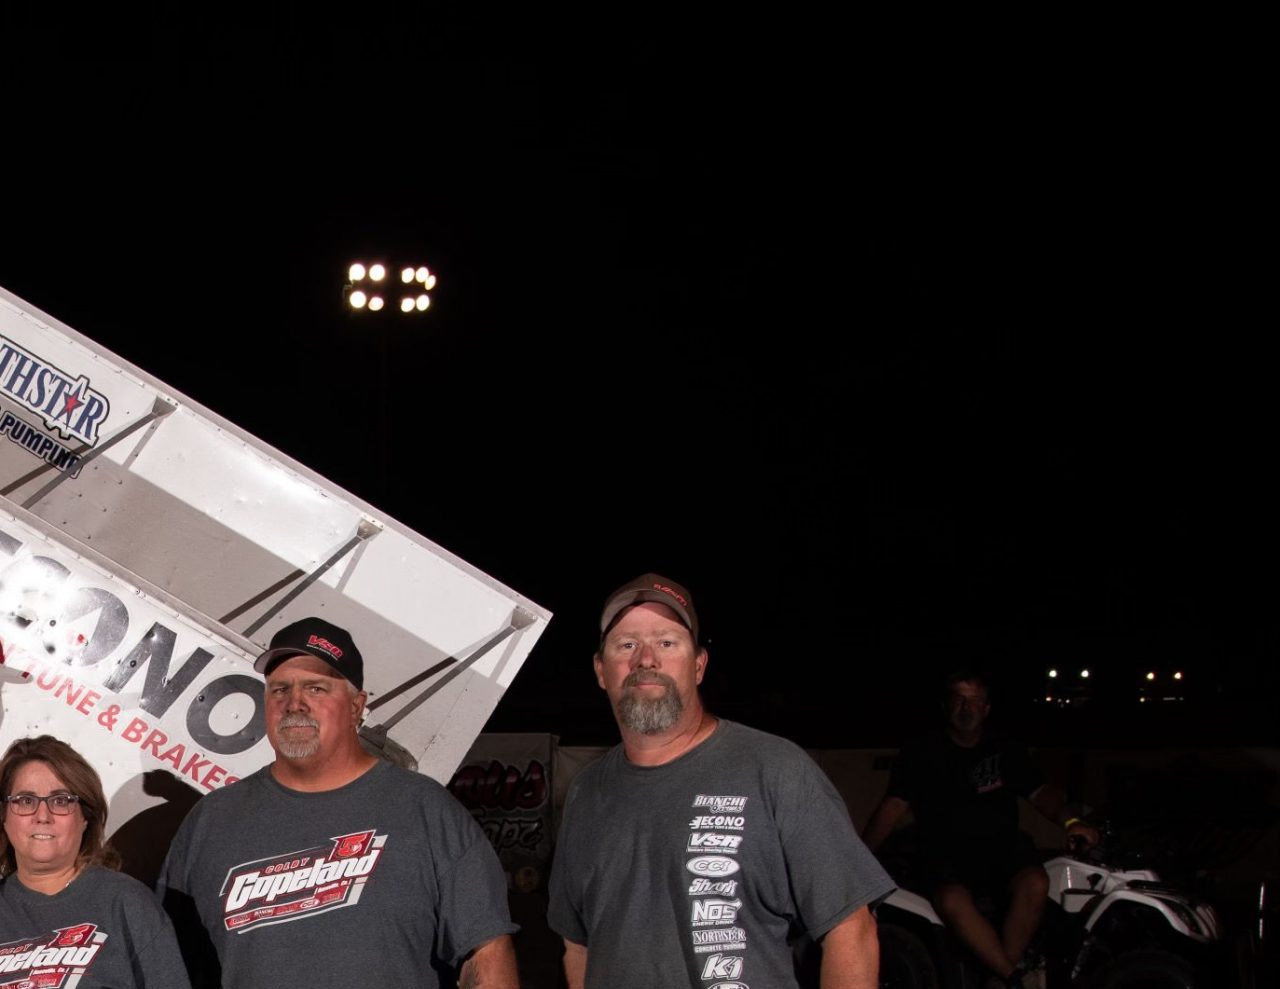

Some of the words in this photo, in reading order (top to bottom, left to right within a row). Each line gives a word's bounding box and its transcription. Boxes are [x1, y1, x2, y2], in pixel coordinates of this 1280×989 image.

[98, 704, 121, 731] &
[693, 794, 747, 807] BIANCHI
[700, 816, 745, 827] ECONO
[690, 832, 743, 847] VSR
[225, 850, 381, 913] Copeland
[692, 898, 742, 921] NOS
